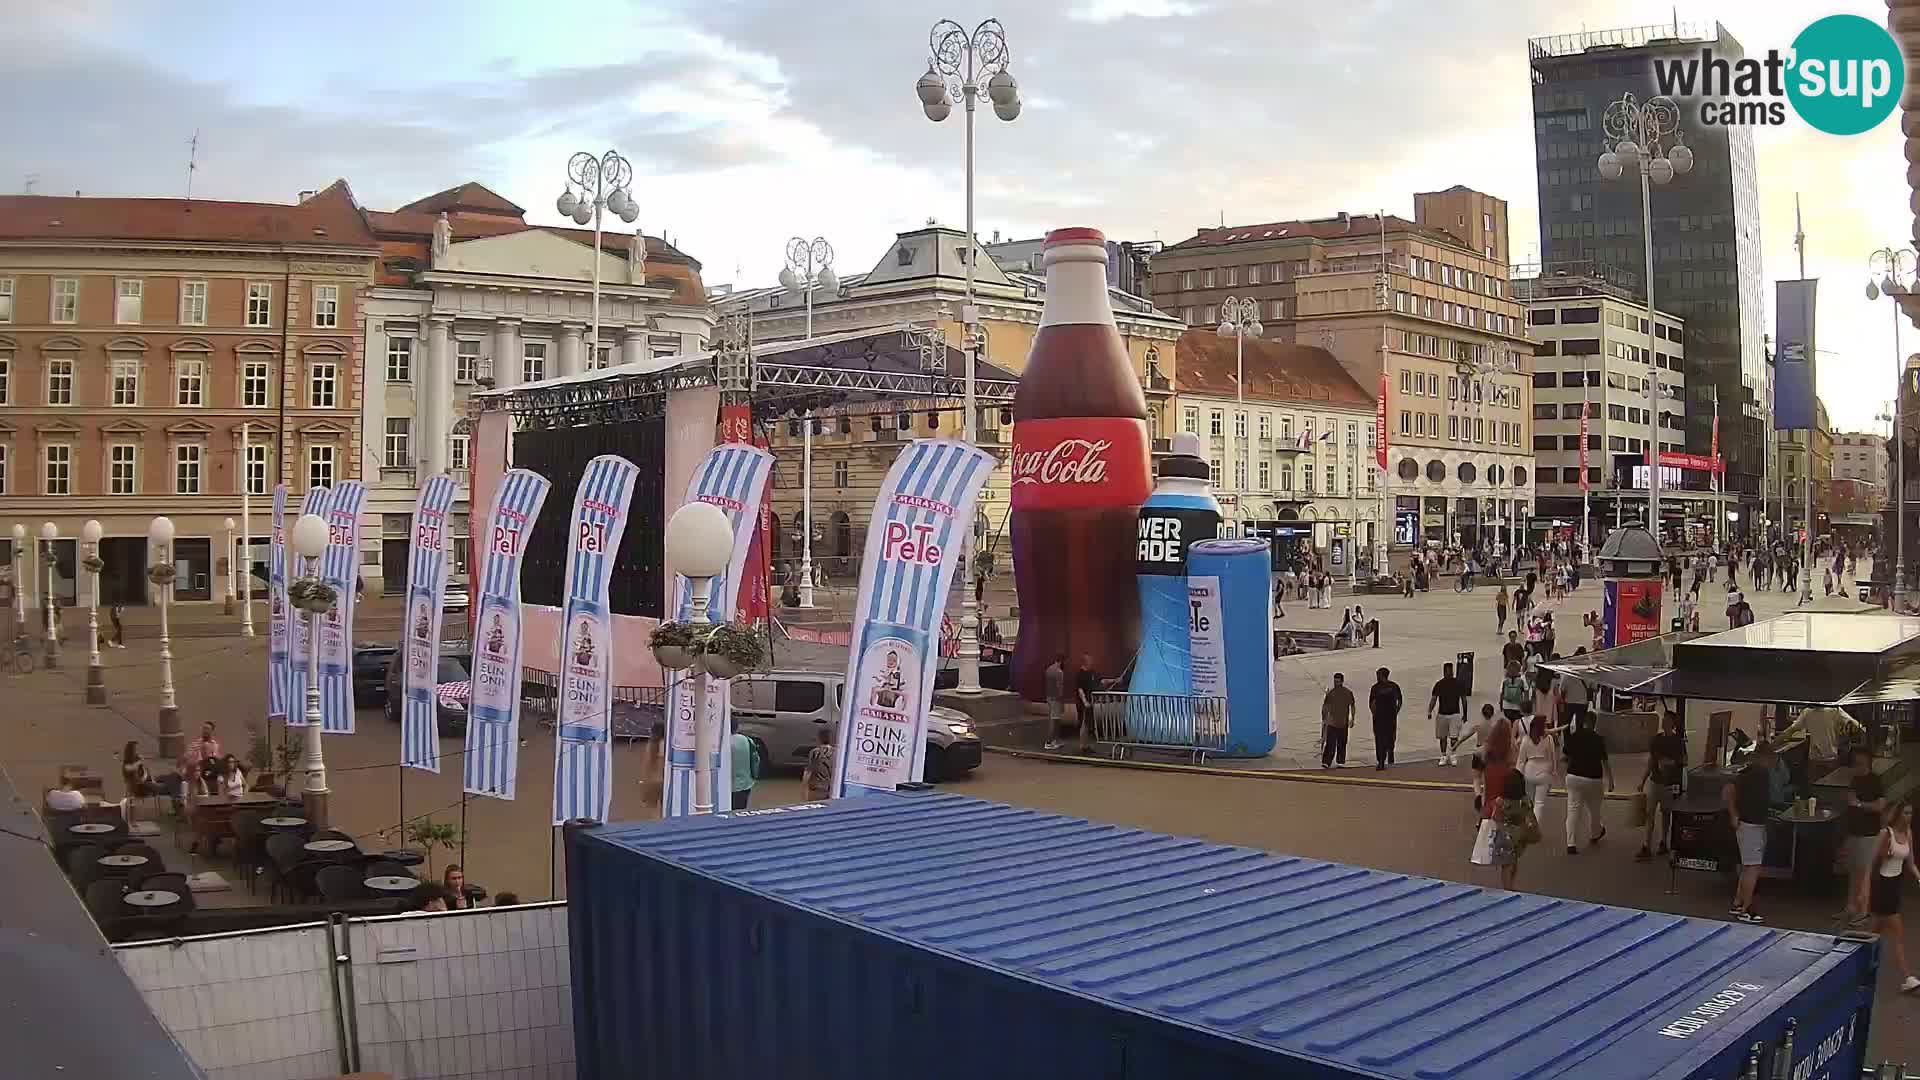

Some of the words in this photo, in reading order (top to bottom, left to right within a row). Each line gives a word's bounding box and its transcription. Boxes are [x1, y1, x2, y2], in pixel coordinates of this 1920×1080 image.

[900, 495, 951, 515] MARASKA
[1138, 518, 1182, 539] WER
[885, 522, 940, 564] PeTe
[855, 738, 905, 758] TONIK
[1657, 1016, 1709, 1039] MCDU
[1690, 990, 1747, 1018] 300629
